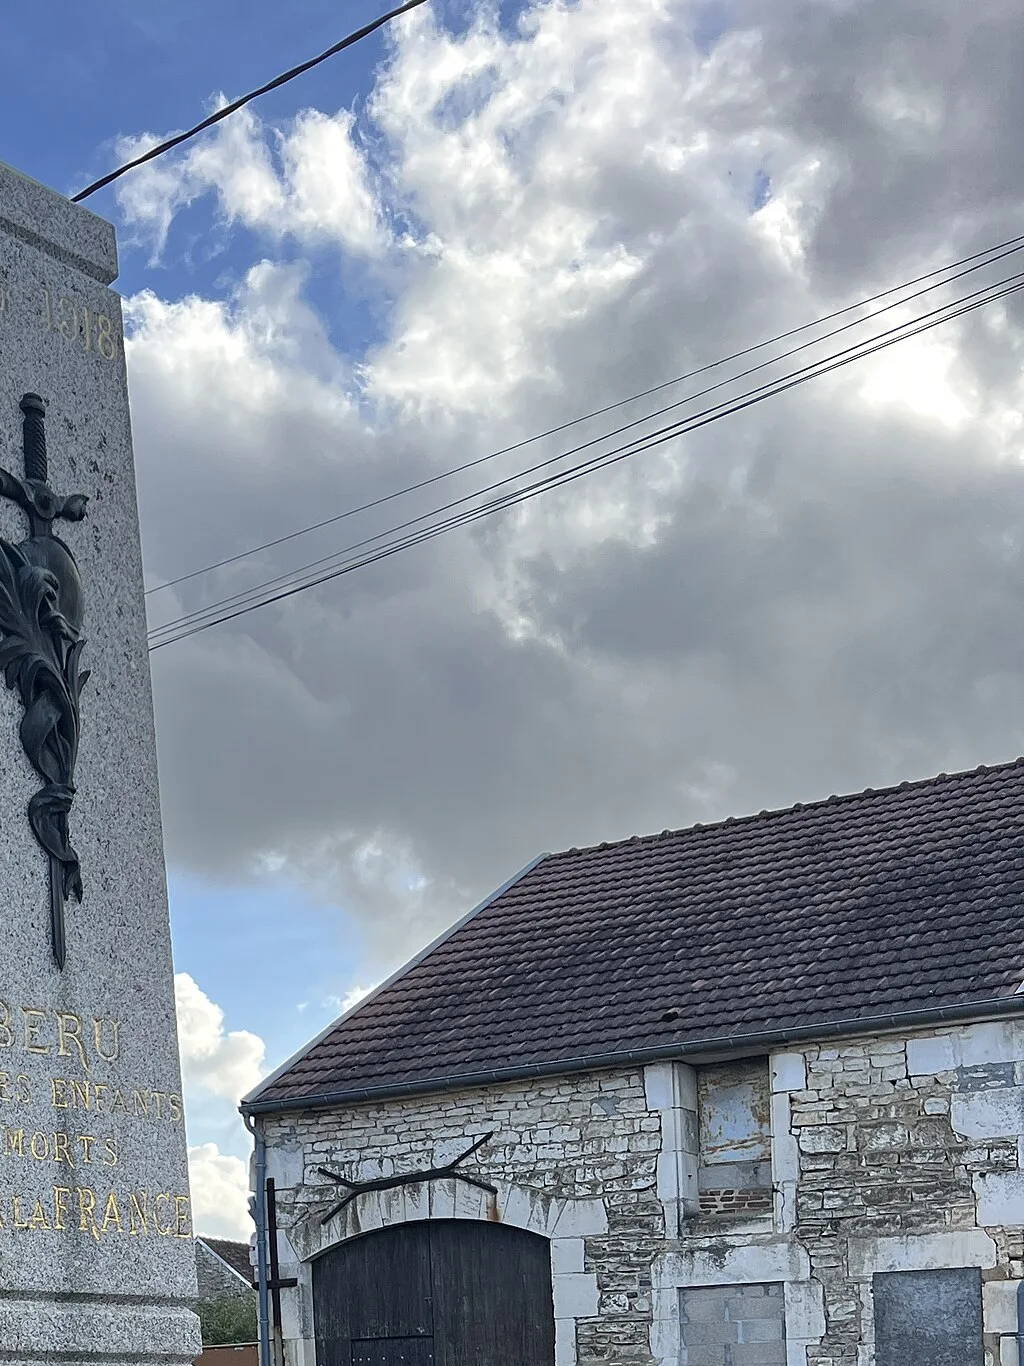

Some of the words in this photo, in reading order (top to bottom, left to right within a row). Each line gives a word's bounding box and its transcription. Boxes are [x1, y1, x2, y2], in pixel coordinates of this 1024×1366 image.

[42, 288, 117, 360] 1918
[50, 1077, 183, 1122] ENFANTS
[1, 1125, 119, 1169] MORTS
[12, 1195, 51, 1229] LA
[53, 1185, 193, 1240] FRANCE
